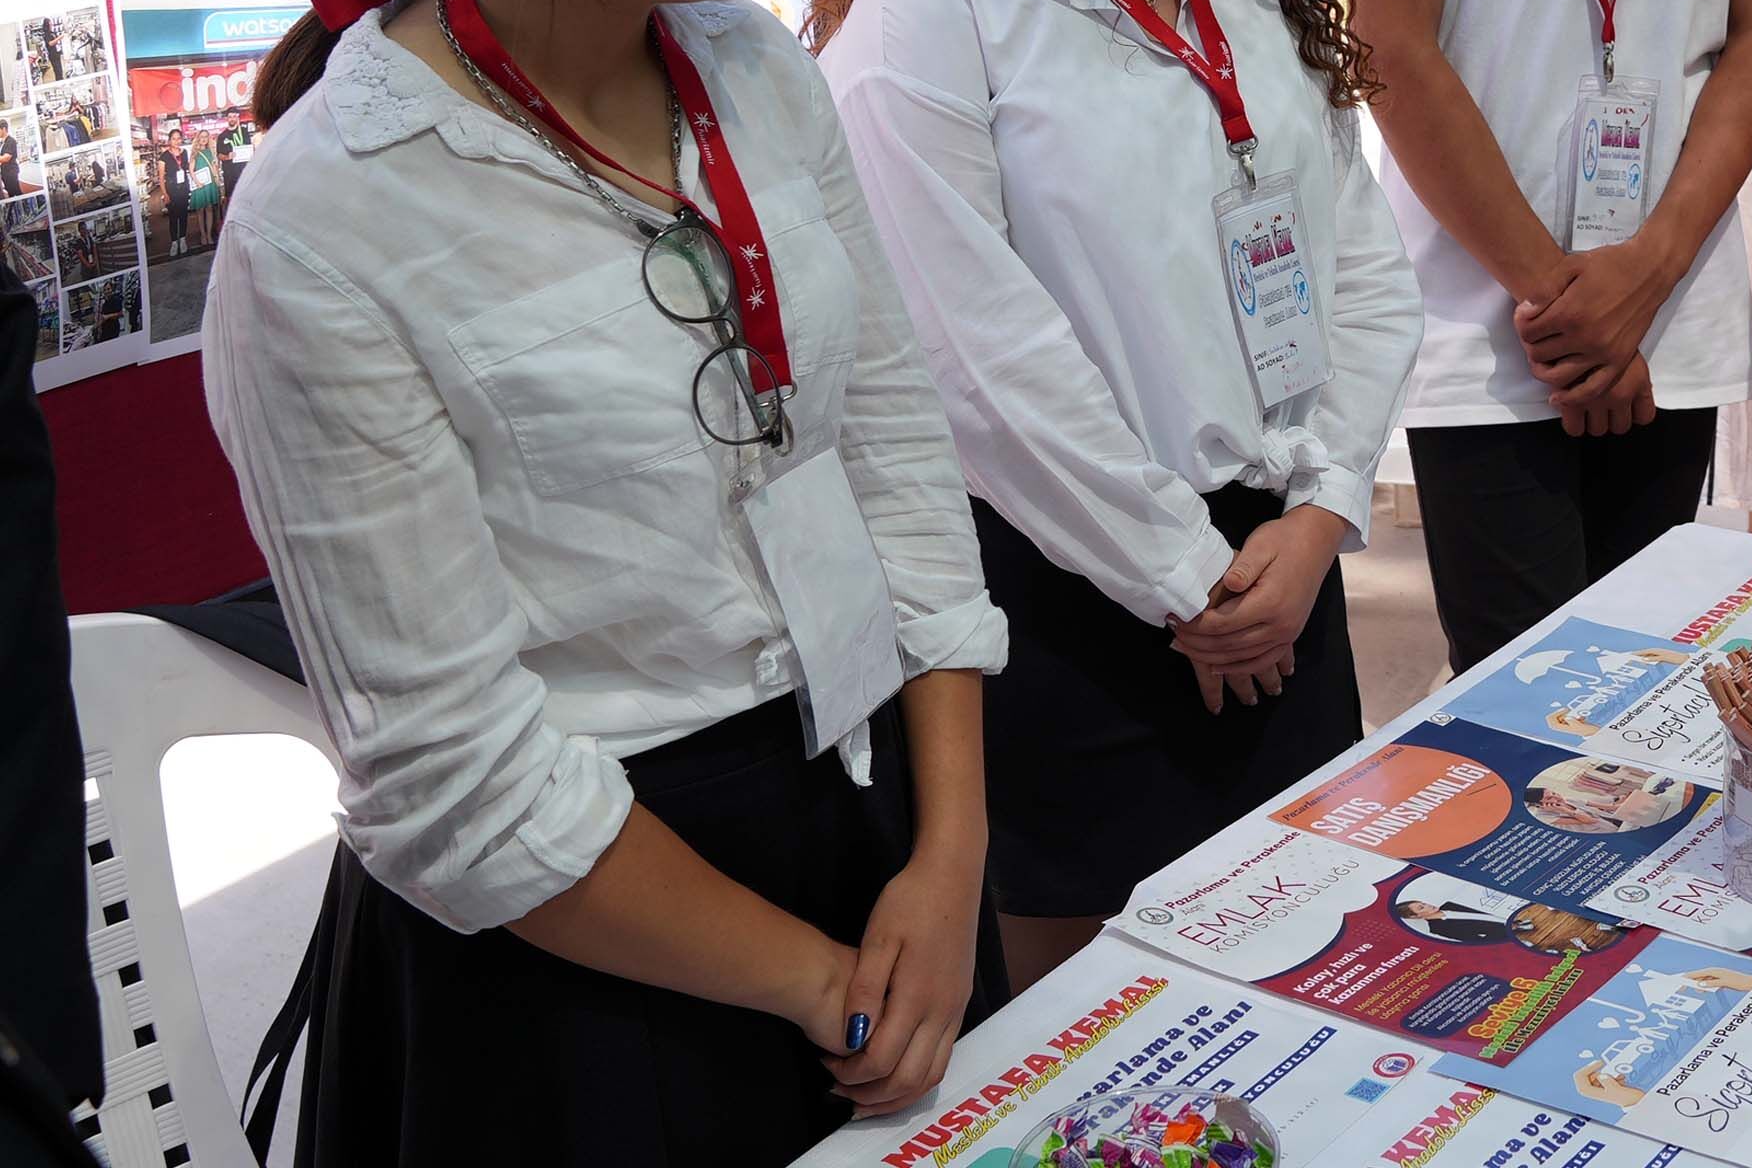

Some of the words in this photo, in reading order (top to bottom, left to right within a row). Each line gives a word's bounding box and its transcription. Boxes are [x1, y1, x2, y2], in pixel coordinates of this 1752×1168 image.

[1310, 796, 1386, 835] SATIŞ
[1347, 762, 1493, 847] DANIŞMANLIĞI
[1164, 875, 1230, 910] Pazarlama
[1227, 865, 1244, 879] ve
[1241, 830, 1300, 869] Perakende
[1638, 846, 1691, 885] Pazarlama
[1687, 835, 1702, 849] ve
[1177, 875, 1307, 946] EMLAK
[1209, 858, 1360, 954] KOMİSYONCULUĞU
[1293, 967, 1338, 993] Kolay,
[1331, 948, 1359, 970] hızlı
[1355, 942, 1374, 954] ve
[1313, 982, 1339, 1000] çok
[1335, 963, 1367, 985] para
[1327, 965, 1388, 1006] kazanma
[1380, 944, 1420, 970] fırsatı
[1183, 1003, 1213, 1027] ve
[1187, 1000, 1253, 1053] Alanı
[1467, 989, 1528, 1040] Seviye
[881, 1052, 1063, 1168] MUSTAFA
[1046, 975, 1169, 1052] KEMAL
[932, 1114, 999, 1168] Mesleki
[996, 1100, 1017, 1121] ve
[1008, 1062, 1067, 1102] Teknik
[1062, 1014, 1125, 1064] Anadolu
[1121, 976, 1170, 1018] Lisesi
[1656, 1045, 1712, 1097] Pazarlama
[1708, 1035, 1725, 1050] ve
[1521, 1112, 1552, 1137] ve
